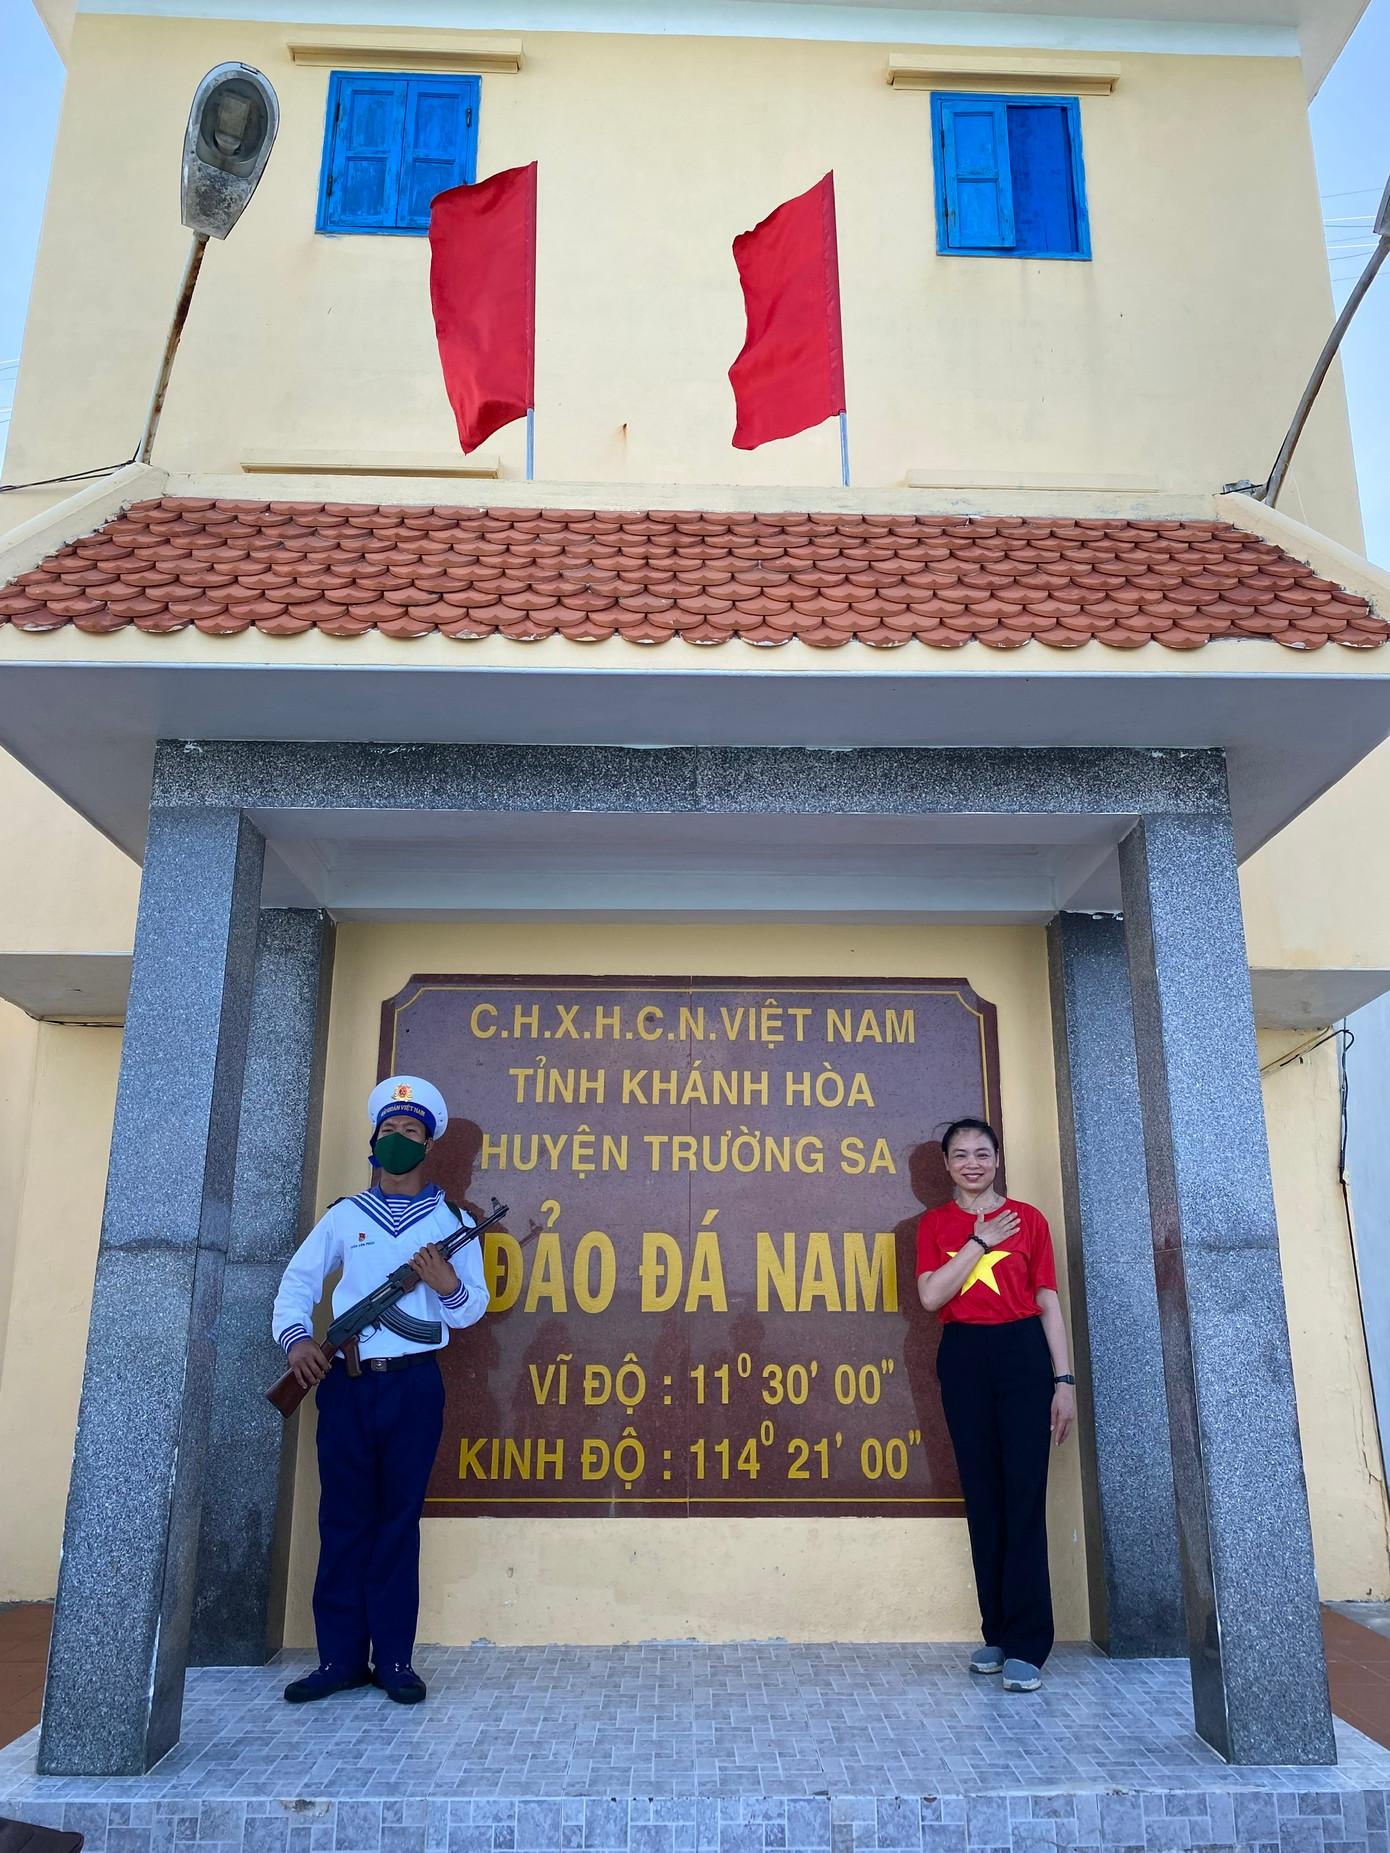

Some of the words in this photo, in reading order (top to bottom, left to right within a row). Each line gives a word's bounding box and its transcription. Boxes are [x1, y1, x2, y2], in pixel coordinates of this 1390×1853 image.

[827, 1009, 915, 1043] NAM
[510, 1056, 606, 1104] TỈNH
[622, 1061, 768, 1106] KHÁNH
[787, 1062, 874, 1108] HÒA
[481, 1124, 628, 1179] HUYỆN
[643, 1126, 824, 1174] TRƯỜNG
[841, 1138, 895, 1175] SA
[483, 1200, 617, 1314] ĐẢO
[639, 1209, 729, 1313] ĐÁ
[757, 1232, 899, 1313] NAM
[529, 1354, 573, 1405] VĨ
[583, 1352, 647, 1415] ĐỘ
[459, 1439, 565, 1480] KINH
[581, 1427, 646, 1490] ĐỘ
